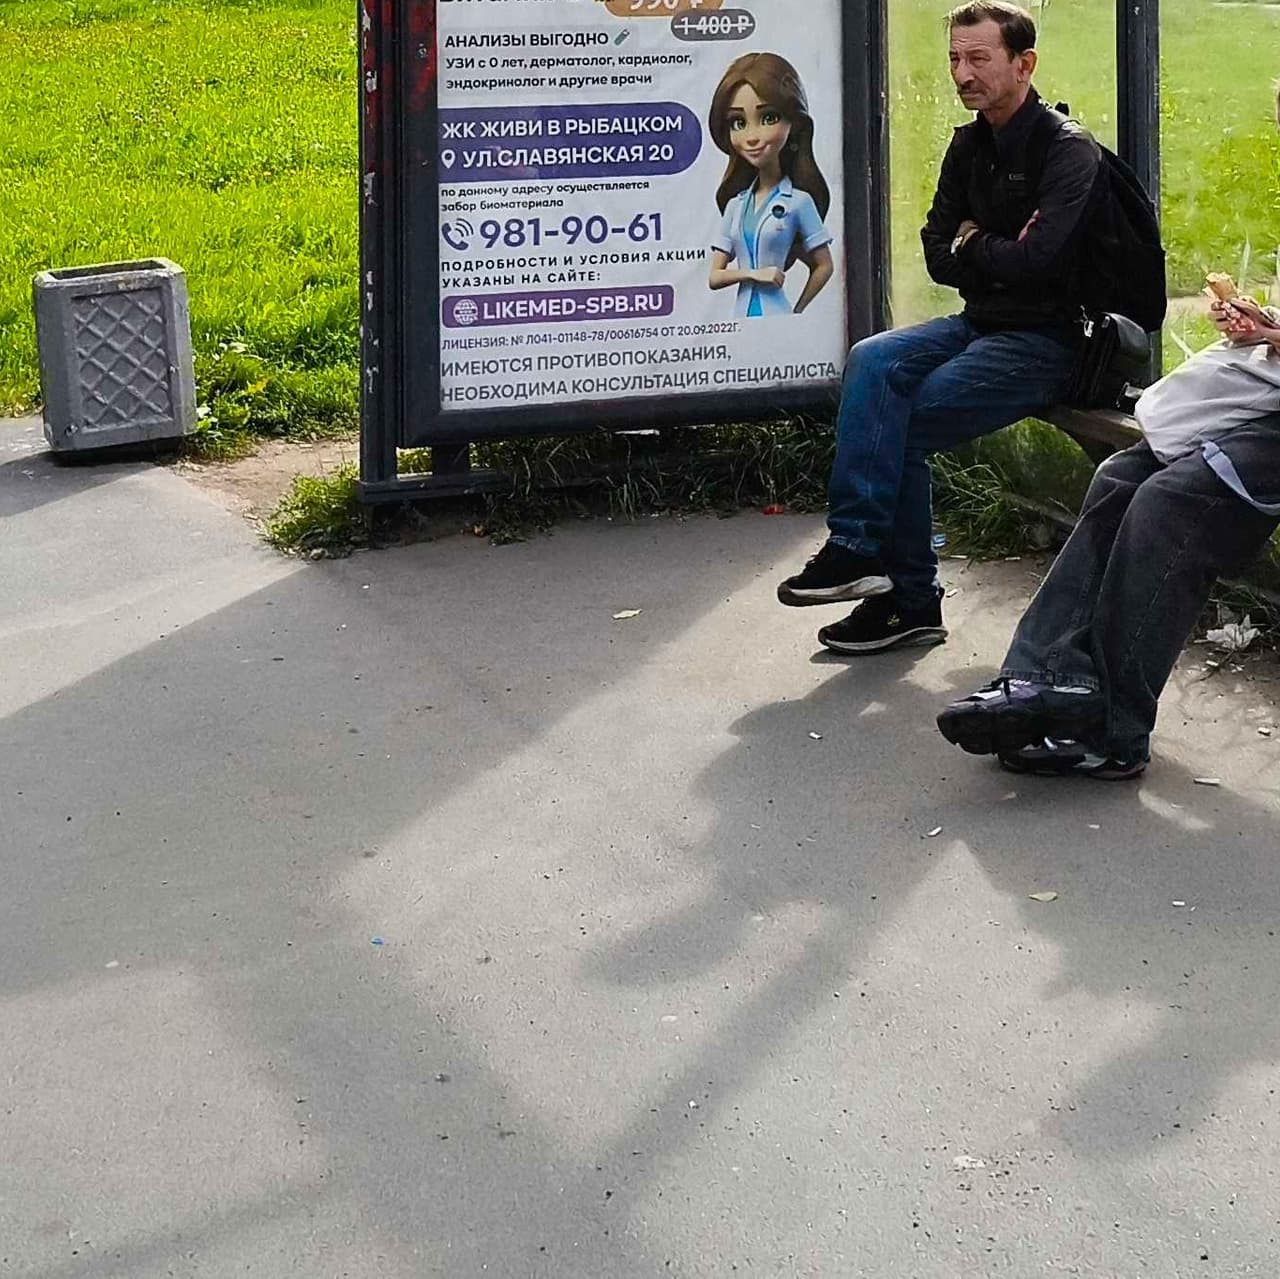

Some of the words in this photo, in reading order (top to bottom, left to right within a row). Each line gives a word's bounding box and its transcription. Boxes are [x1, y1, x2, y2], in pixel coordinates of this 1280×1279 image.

[445, 33, 525, 48] АНАЛИЗЫ
[530, 32, 609, 47] ВЫГОДНО
[446, 58, 476, 69] УЗИ
[478, 60, 486, 68] с
[502, 58, 527, 70] лет,
[530, 56, 615, 70] дерматолог,
[618, 53, 692, 67] кардиолог,
[447, 76, 546, 91] эндокринолог
[548, 77, 556, 86] и
[559, 75, 607, 89] другие
[611, 74, 652, 87] врачи
[442, 122, 475, 139] ЖК
[480, 120, 542, 138] ЖИВИ
[548, 120, 561, 136] В
[565, 116, 682, 135] РЫБАЦКОМ
[463, 146, 643, 168] УЛ.СЛАВЯНСКАЯ
[649, 144, 674, 161] 20
[441, 189, 456, 198] по
[458, 187, 509, 198] данному
[512, 185, 553, 196] адресу
[556, 181, 649, 194] осуществляется
[441, 201, 477, 213] забор
[480, 199, 564, 211] биоматериала
[479, 213, 662, 249] 981-90-61
[441, 256, 558, 272] ПОДРОБНОСТИ
[564, 256, 573, 265] И
[580, 252, 650, 266] УСЛОВИЯ
[656, 249, 706, 262] АКЦИИ
[442, 276, 515, 288] УКАЗАНЫ
[521, 274, 541, 284] НА
[547, 270, 601, 283] САЙТЕ:
[483, 293, 663, 320] LIKEMED-SPB.RU
[442, 336, 509, 351] ЛИЦЕНЗИЯ:
[661, 326, 675, 337] ОТ
[441, 357, 532, 377] ИМЕЮТСЯ
[538, 345, 731, 370] ПРОТИВОПОКАЗАНИЯ,
[441, 381, 567, 402] НЕОБХОДИМА
[572, 371, 709, 393] КОНСУЛЬТАЦИЯ
[713, 362, 840, 384] СПЕЦИАЛИСТА.
